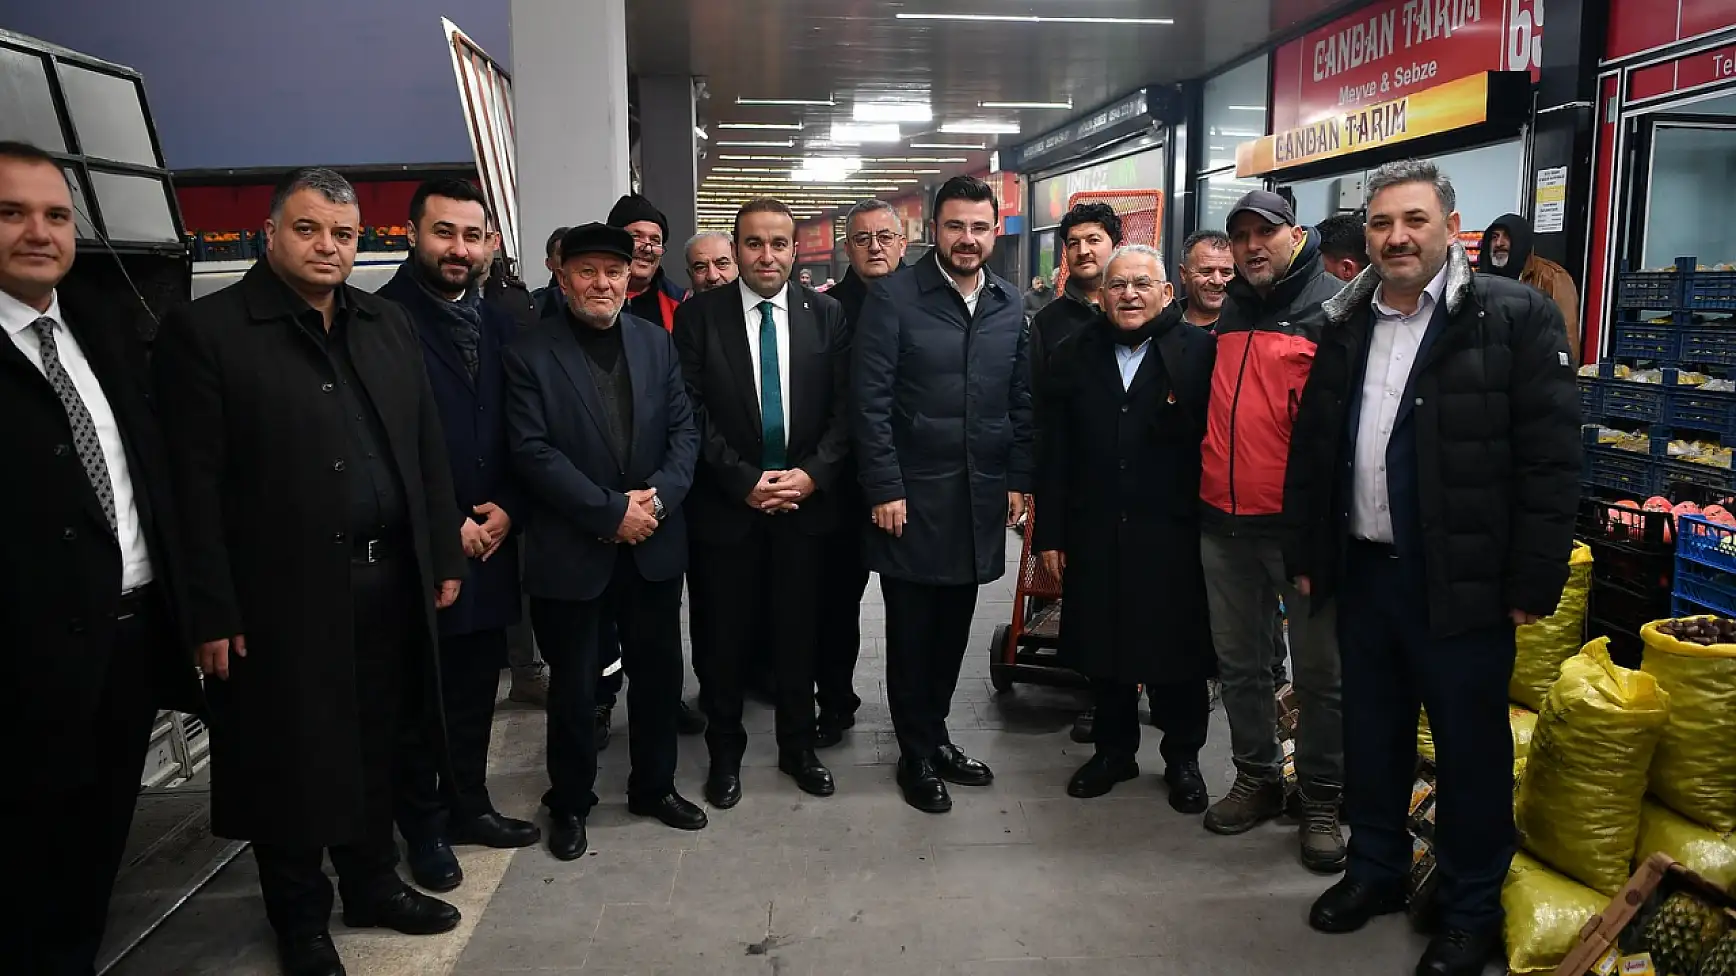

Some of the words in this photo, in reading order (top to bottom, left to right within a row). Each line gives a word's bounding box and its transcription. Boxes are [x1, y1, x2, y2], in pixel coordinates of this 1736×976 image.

[1313, 9, 1396, 83] CANDAN
[1338, 81, 1377, 106] Meyve
[1380, 72, 1390, 92] &
[1394, 60, 1437, 88] Sebze
[1275, 120, 1340, 162] CANDAN
[1345, 99, 1406, 146] TARIM
